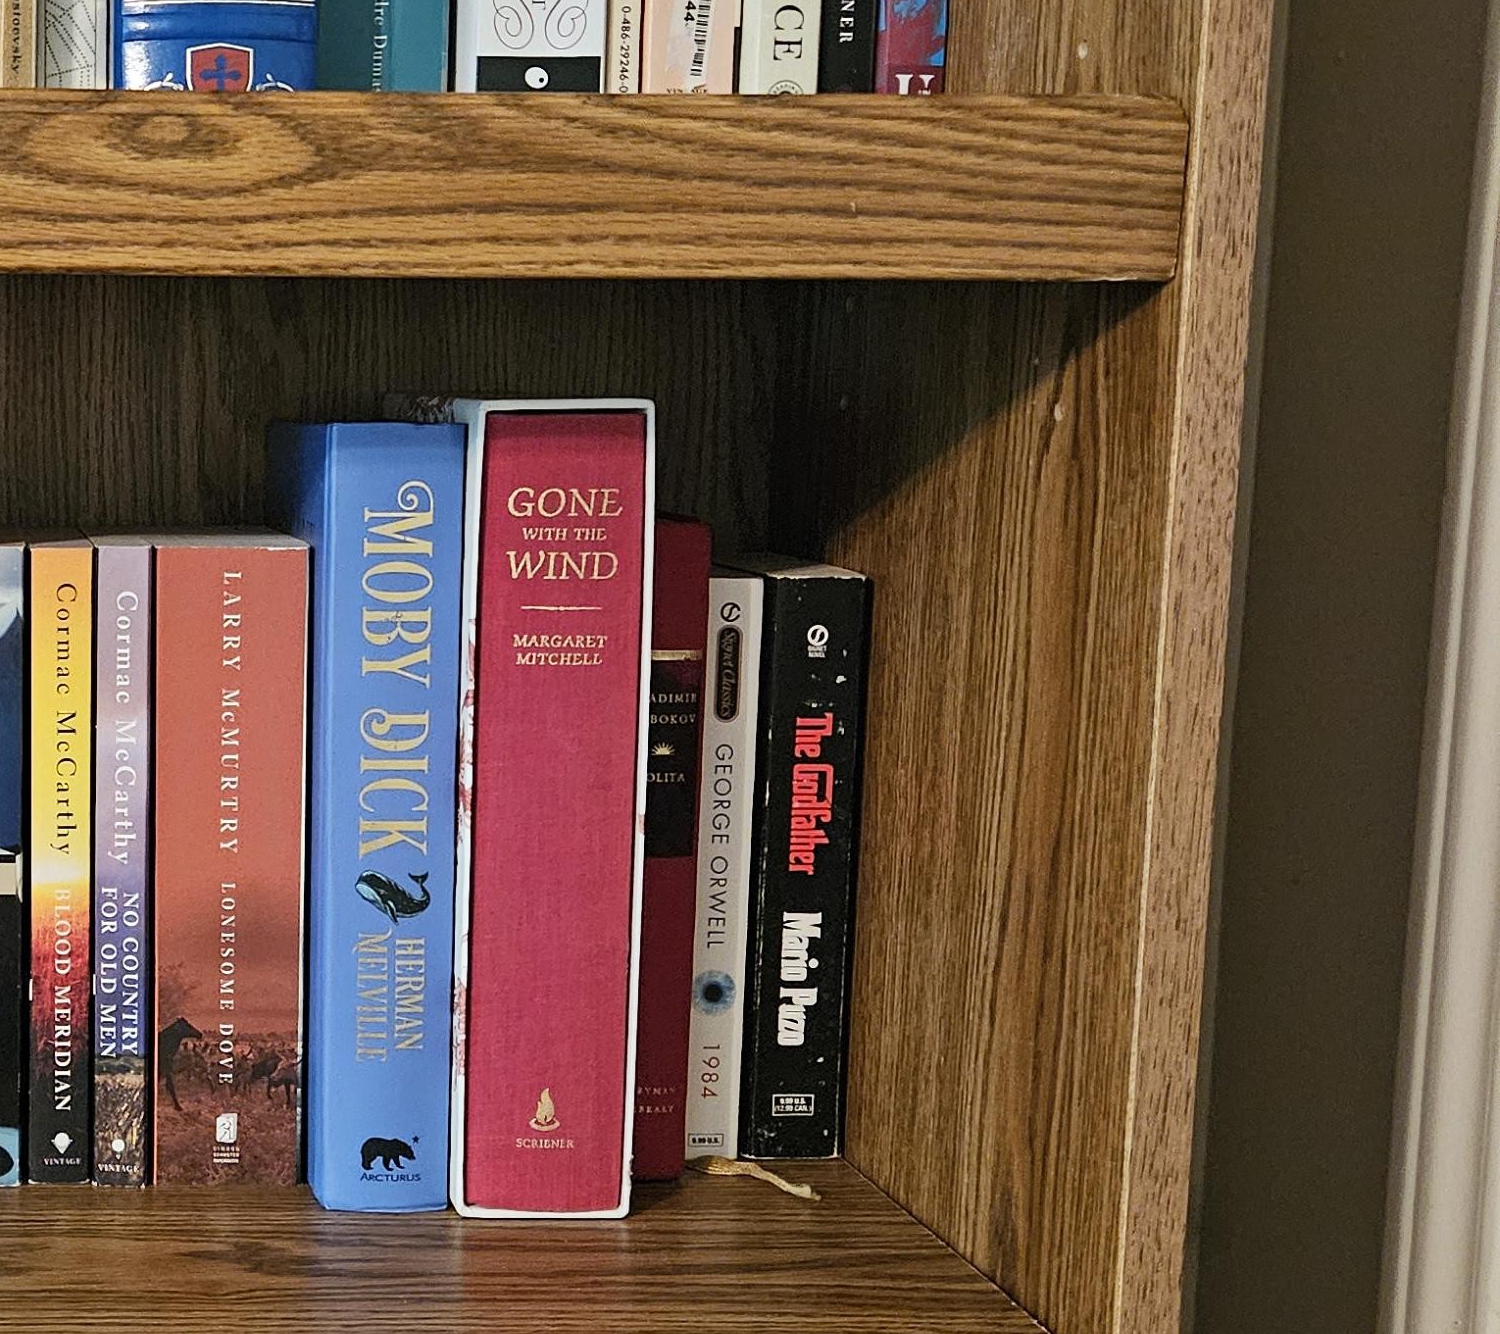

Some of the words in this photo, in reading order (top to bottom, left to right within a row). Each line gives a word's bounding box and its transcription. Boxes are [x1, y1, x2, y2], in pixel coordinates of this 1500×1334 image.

[507, 487, 623, 517] GONE
[522, 527, 567, 541] WITH
[574, 528, 607, 541] THE
[361, 481, 435, 686] MOBY
[506, 550, 618, 580] WIND
[513, 634, 607, 648] MARGARET
[516, 653, 603, 666] MITCHELL
[793, 713, 833, 758] The
[358, 708, 433, 859] DICK
[709, 744, 734, 845] GEORGE
[789, 765, 833, 874] Godfather
[705, 855, 730, 949] ORWELL
[779, 913, 821, 981] Mario
[777, 988, 817, 1046] Puzo
[700, 1043, 721, 1100] 1984
